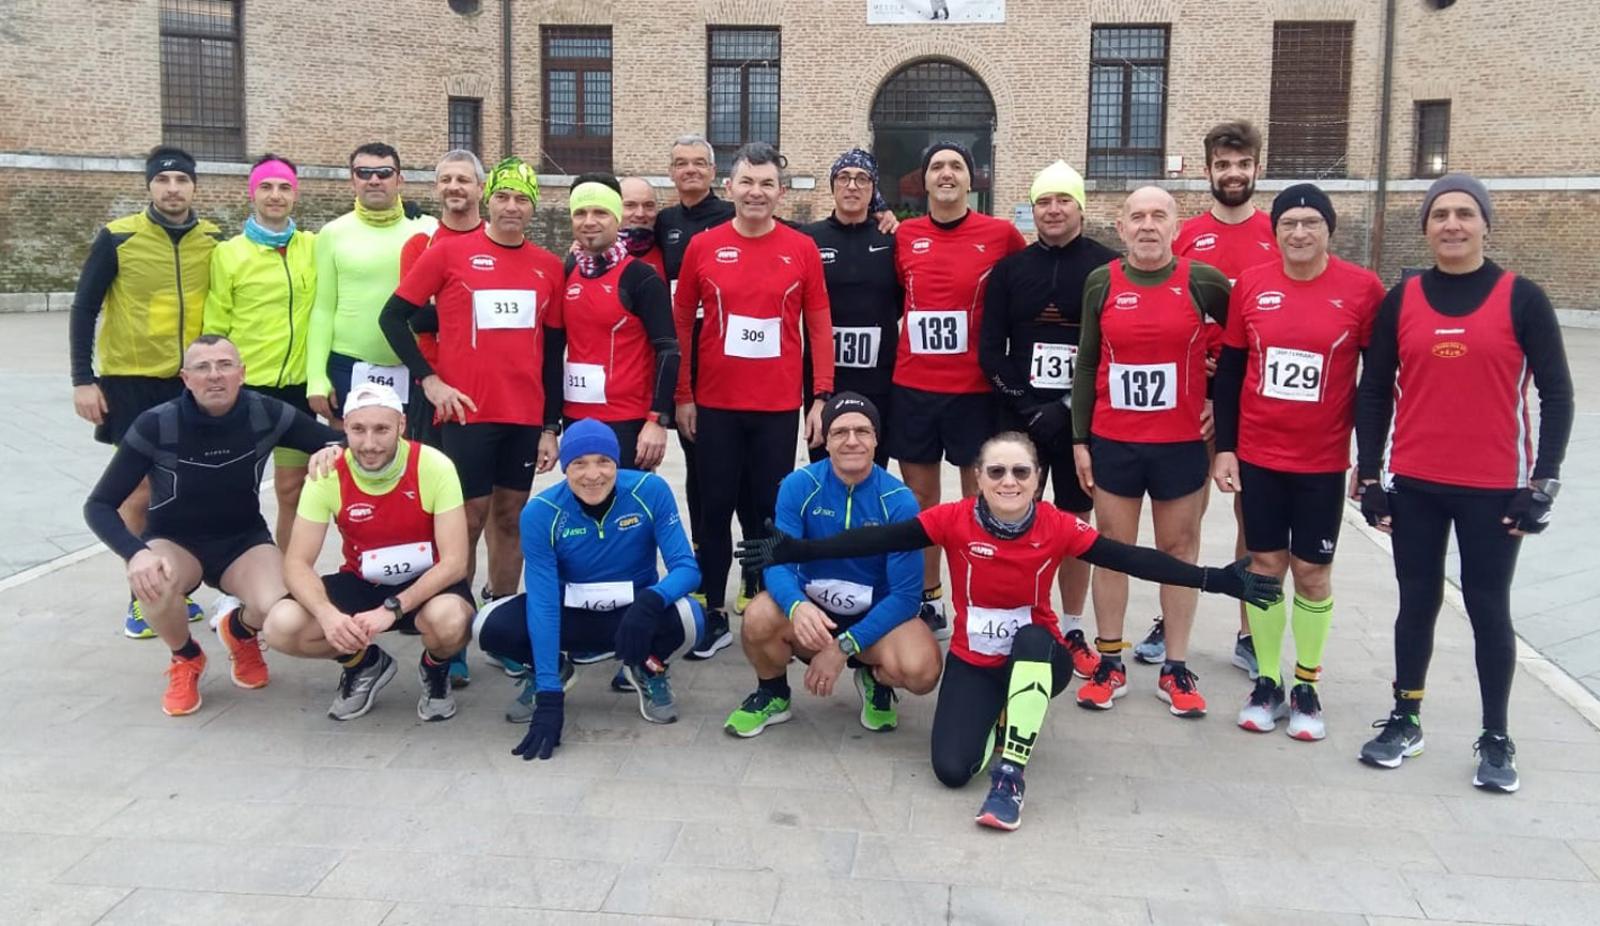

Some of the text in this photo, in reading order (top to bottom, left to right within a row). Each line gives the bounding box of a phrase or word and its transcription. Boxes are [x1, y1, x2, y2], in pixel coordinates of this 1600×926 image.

[494, 302, 519, 314] 313
[741, 328, 765, 343] 309
[918, 317, 958, 351] 133
[833, 331, 872, 365] 130
[1034, 355, 1075, 379] 131
[1268, 361, 1320, 390] 129
[568, 374, 586, 388] 311
[1121, 370, 1166, 408] 132
[383, 562, 413, 577] 312
[817, 589, 856, 610] 465
